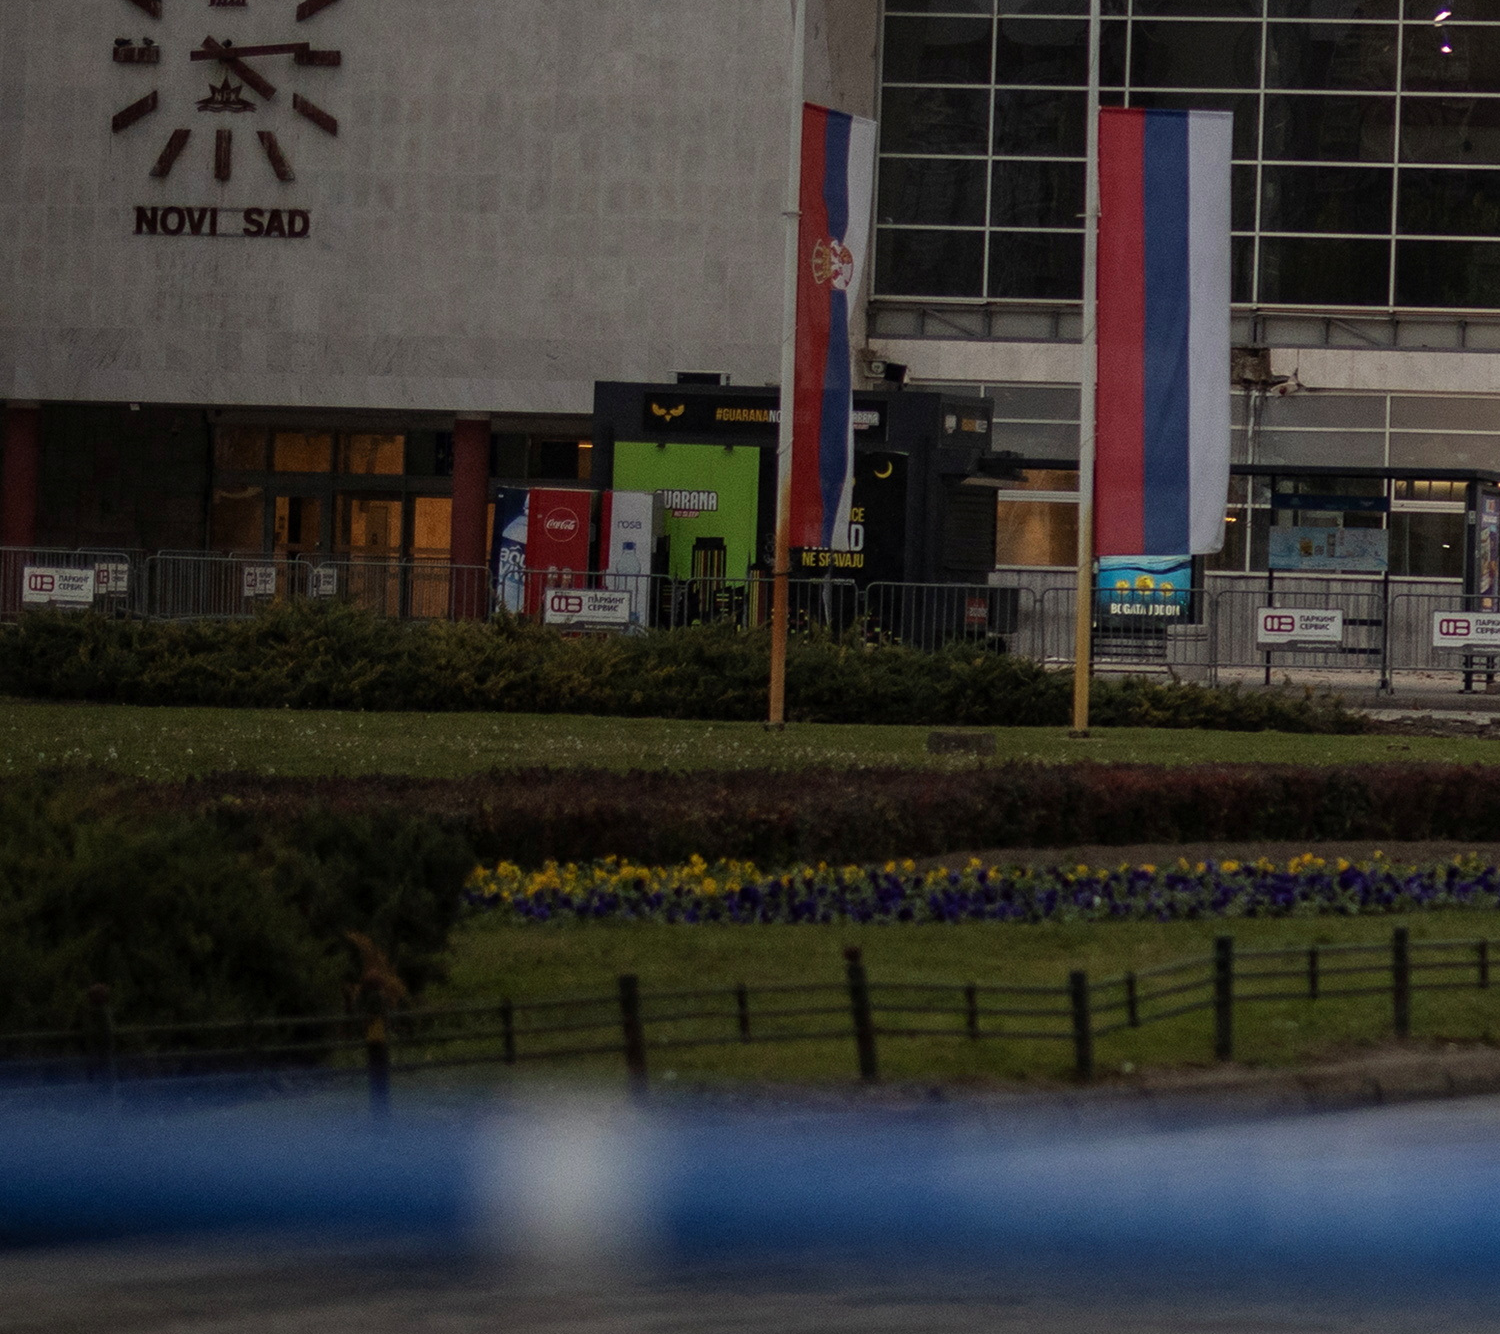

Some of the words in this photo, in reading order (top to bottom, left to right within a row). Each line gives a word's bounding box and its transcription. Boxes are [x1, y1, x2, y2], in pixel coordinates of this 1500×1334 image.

[135, 206, 218, 236] NOVI
[243, 208, 310, 238] SAD
[656, 490, 718, 511] UARANA
[617, 518, 642, 530] rosa
[587, 604, 620, 612] СЕРВИС
[1299, 623, 1331, 631] СЕРВИС
